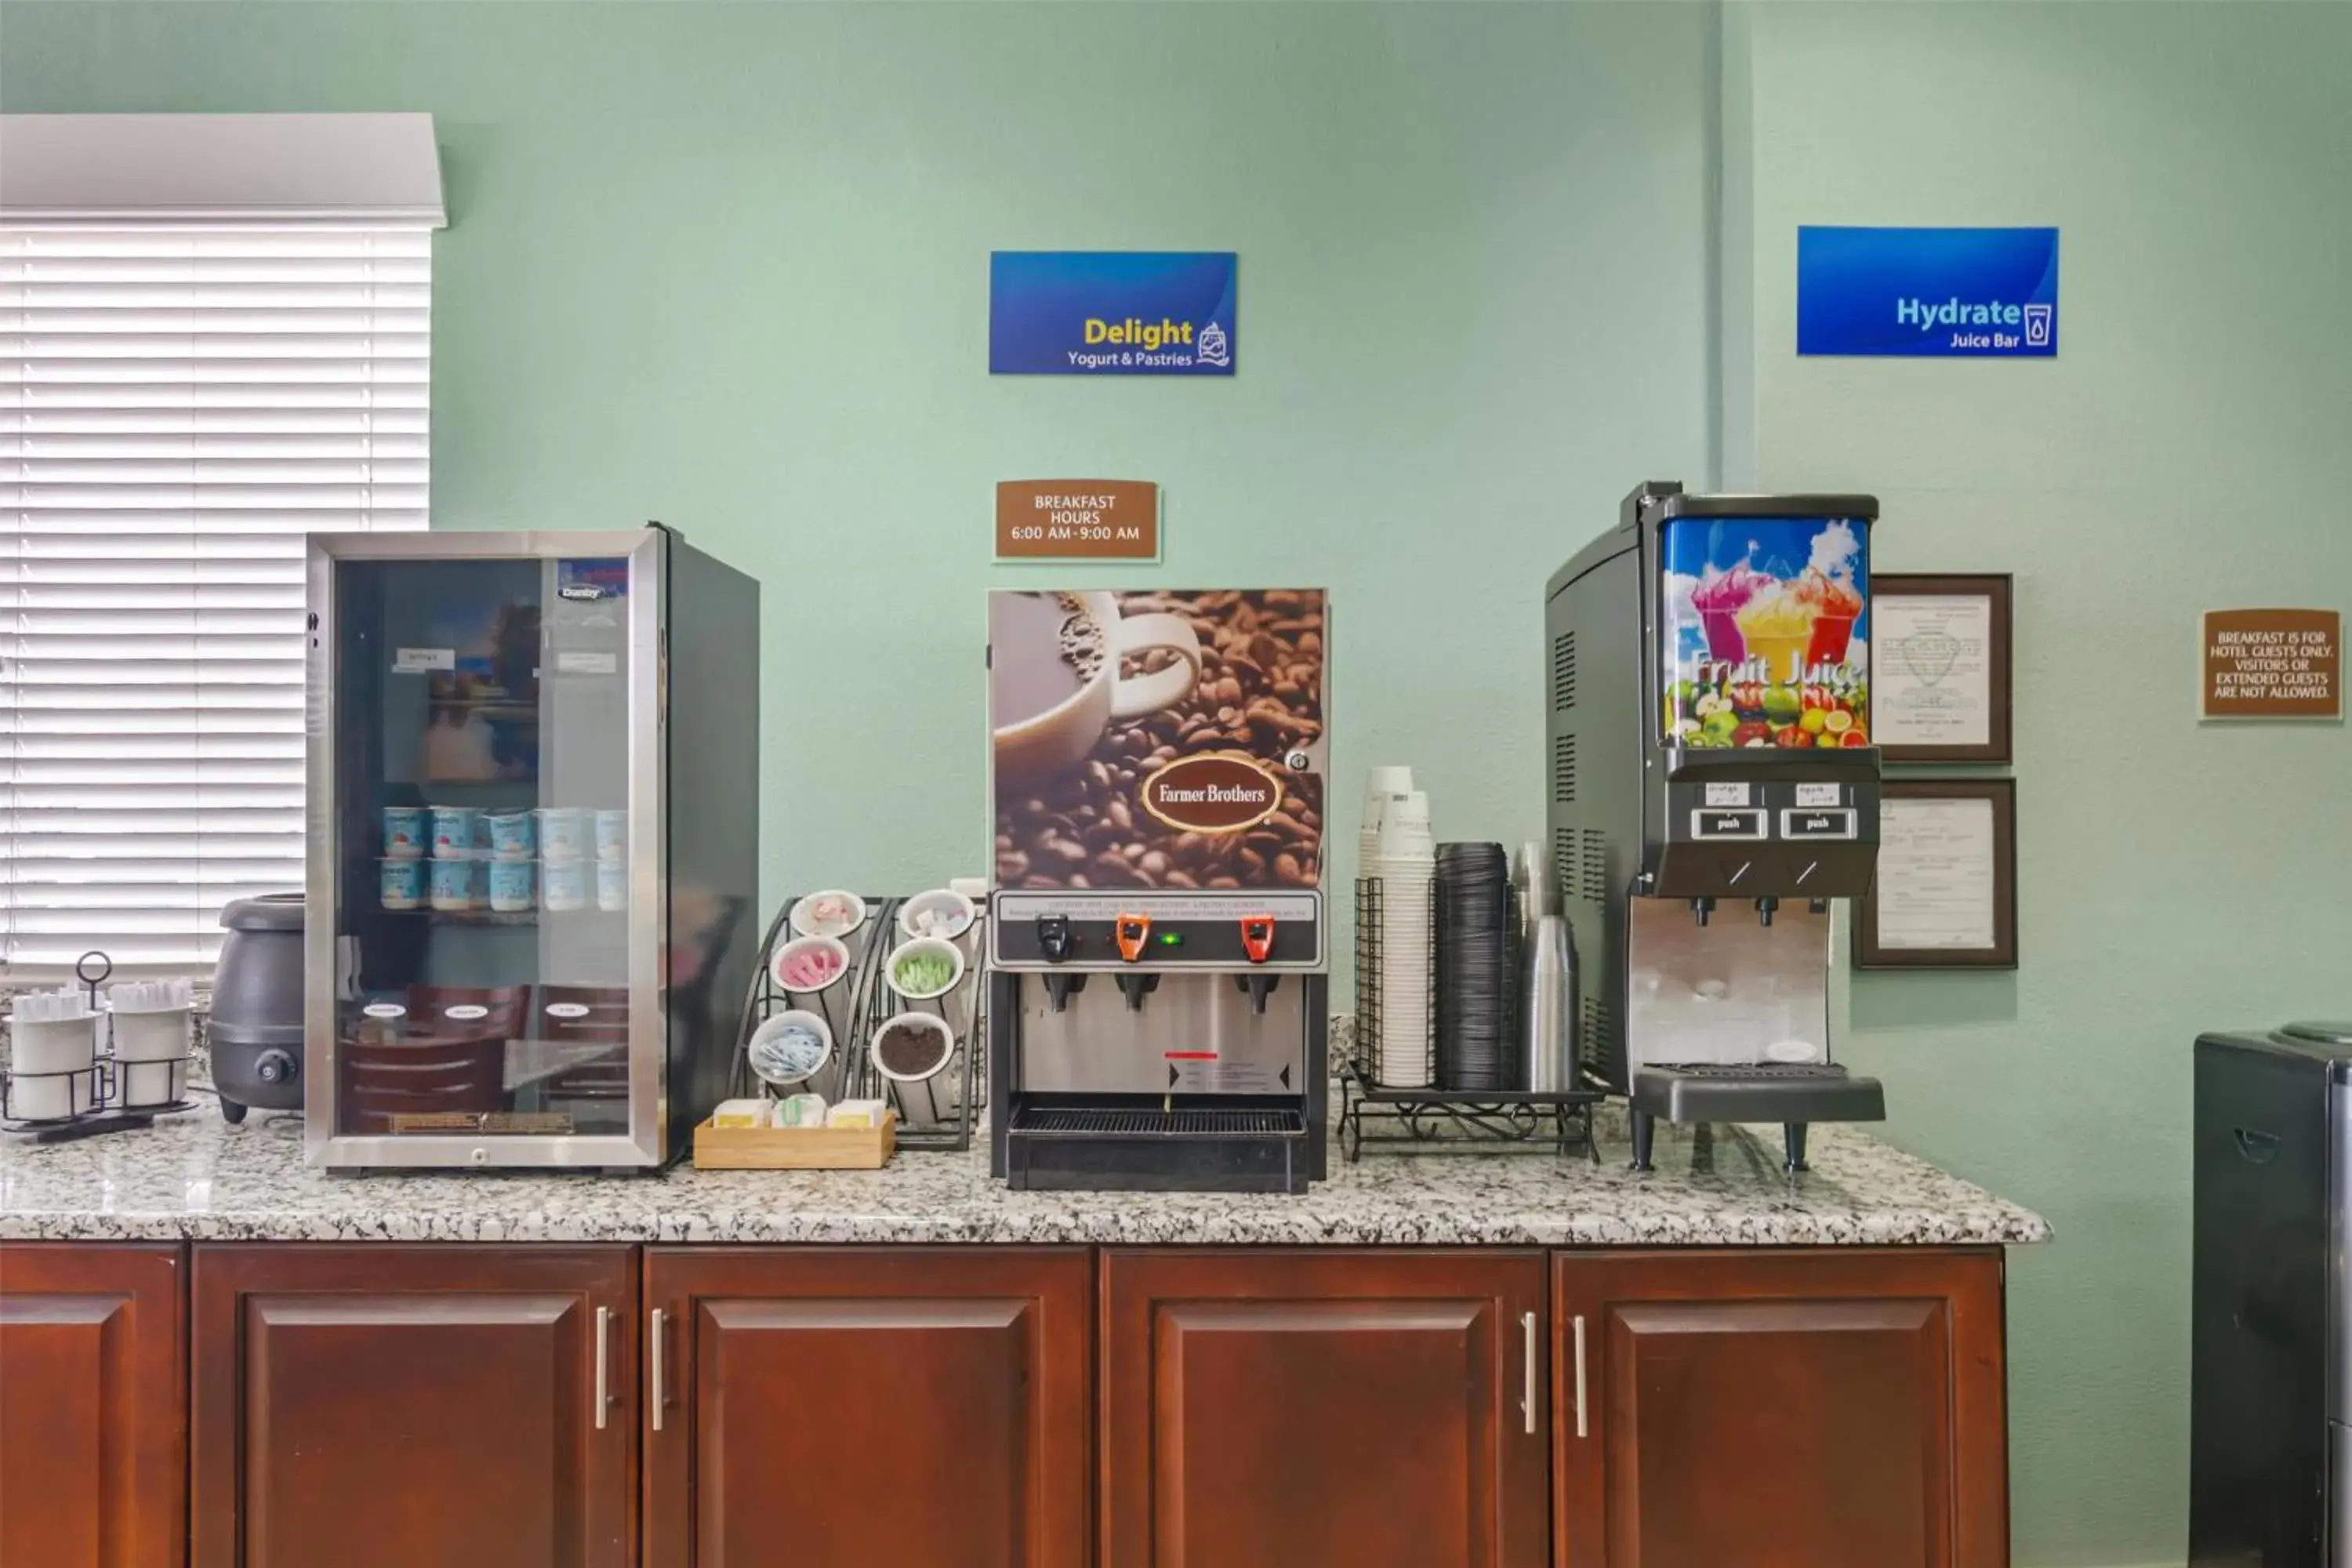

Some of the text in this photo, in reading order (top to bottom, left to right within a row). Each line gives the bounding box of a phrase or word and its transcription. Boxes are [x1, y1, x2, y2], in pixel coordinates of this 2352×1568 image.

[1897, 297, 2021, 331] Hydrate
[1085, 318, 1192, 350] Delight
[1951, 333, 2020, 347] Juice Bar
[1068, 352, 1192, 368] Yogurt & Pastries
[1034, 495, 1116, 509] BREAKFAST
[1051, 511, 1100, 524] HOURS
[1011, 526, 1043, 539] 6:00
[1116, 527, 1139, 539] AM
[2218, 631, 2326, 644] BREAKFAST IS FOR
[2210, 645, 2248, 658] HOTEL
[2252, 645, 2297, 658] GUESTS
[1691, 649, 1771, 685] Fruit
[2234, 659, 2310, 671] VISITORS OR
[2216, 673, 2328, 684] EXTENDED GUESTS
[2214, 686, 2236, 698] ARE
[2240, 686, 2266, 698] NOT
[1160, 784, 1265, 802] Farmer Brothers
[1718, 817, 1829, 831] push push
